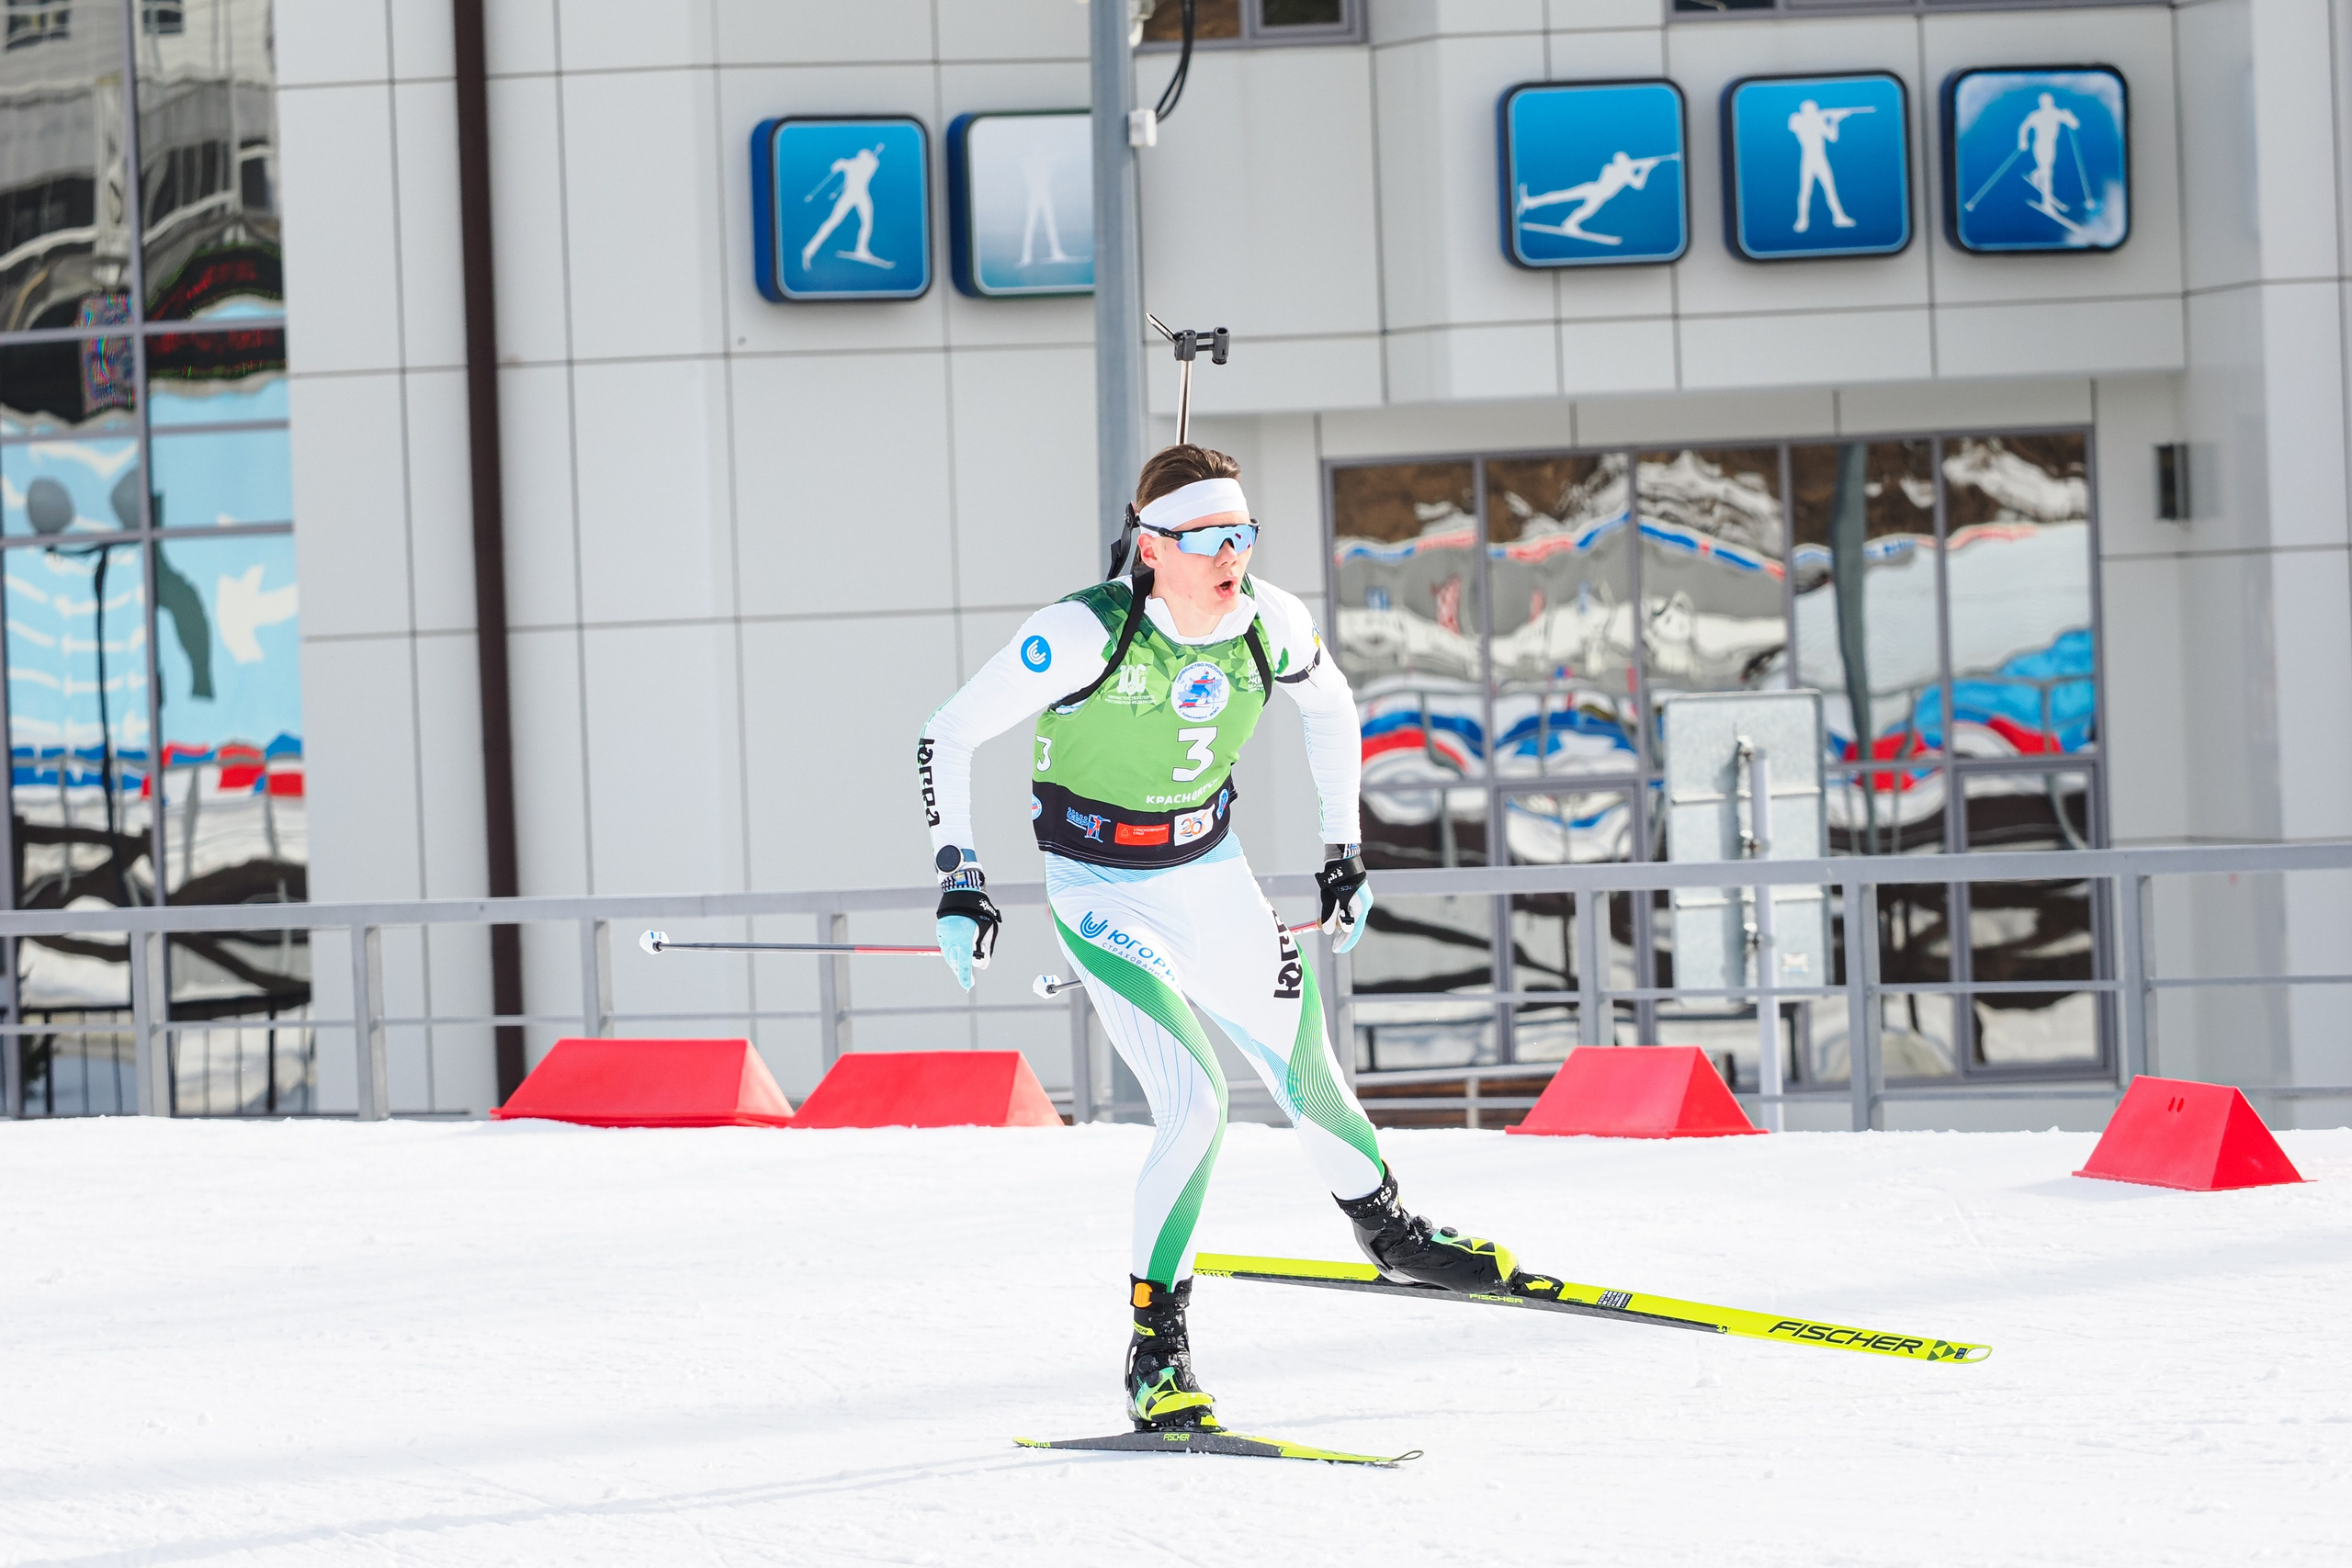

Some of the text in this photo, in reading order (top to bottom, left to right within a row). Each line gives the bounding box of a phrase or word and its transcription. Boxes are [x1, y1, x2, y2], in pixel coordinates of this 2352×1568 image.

[1177, 663, 1224, 682] ПЕРВЕНСТВО РОССИИ
[1035, 736, 1052, 772] 3
[1171, 726, 1217, 782] 3
[1102, 942, 1164, 980] СТРАХОВАНИЕ
[1469, 1293, 1524, 1304] FISCHER
[1768, 1320, 1925, 1354] FISCHER
[1163, 1433, 1191, 1442] FISCHER
